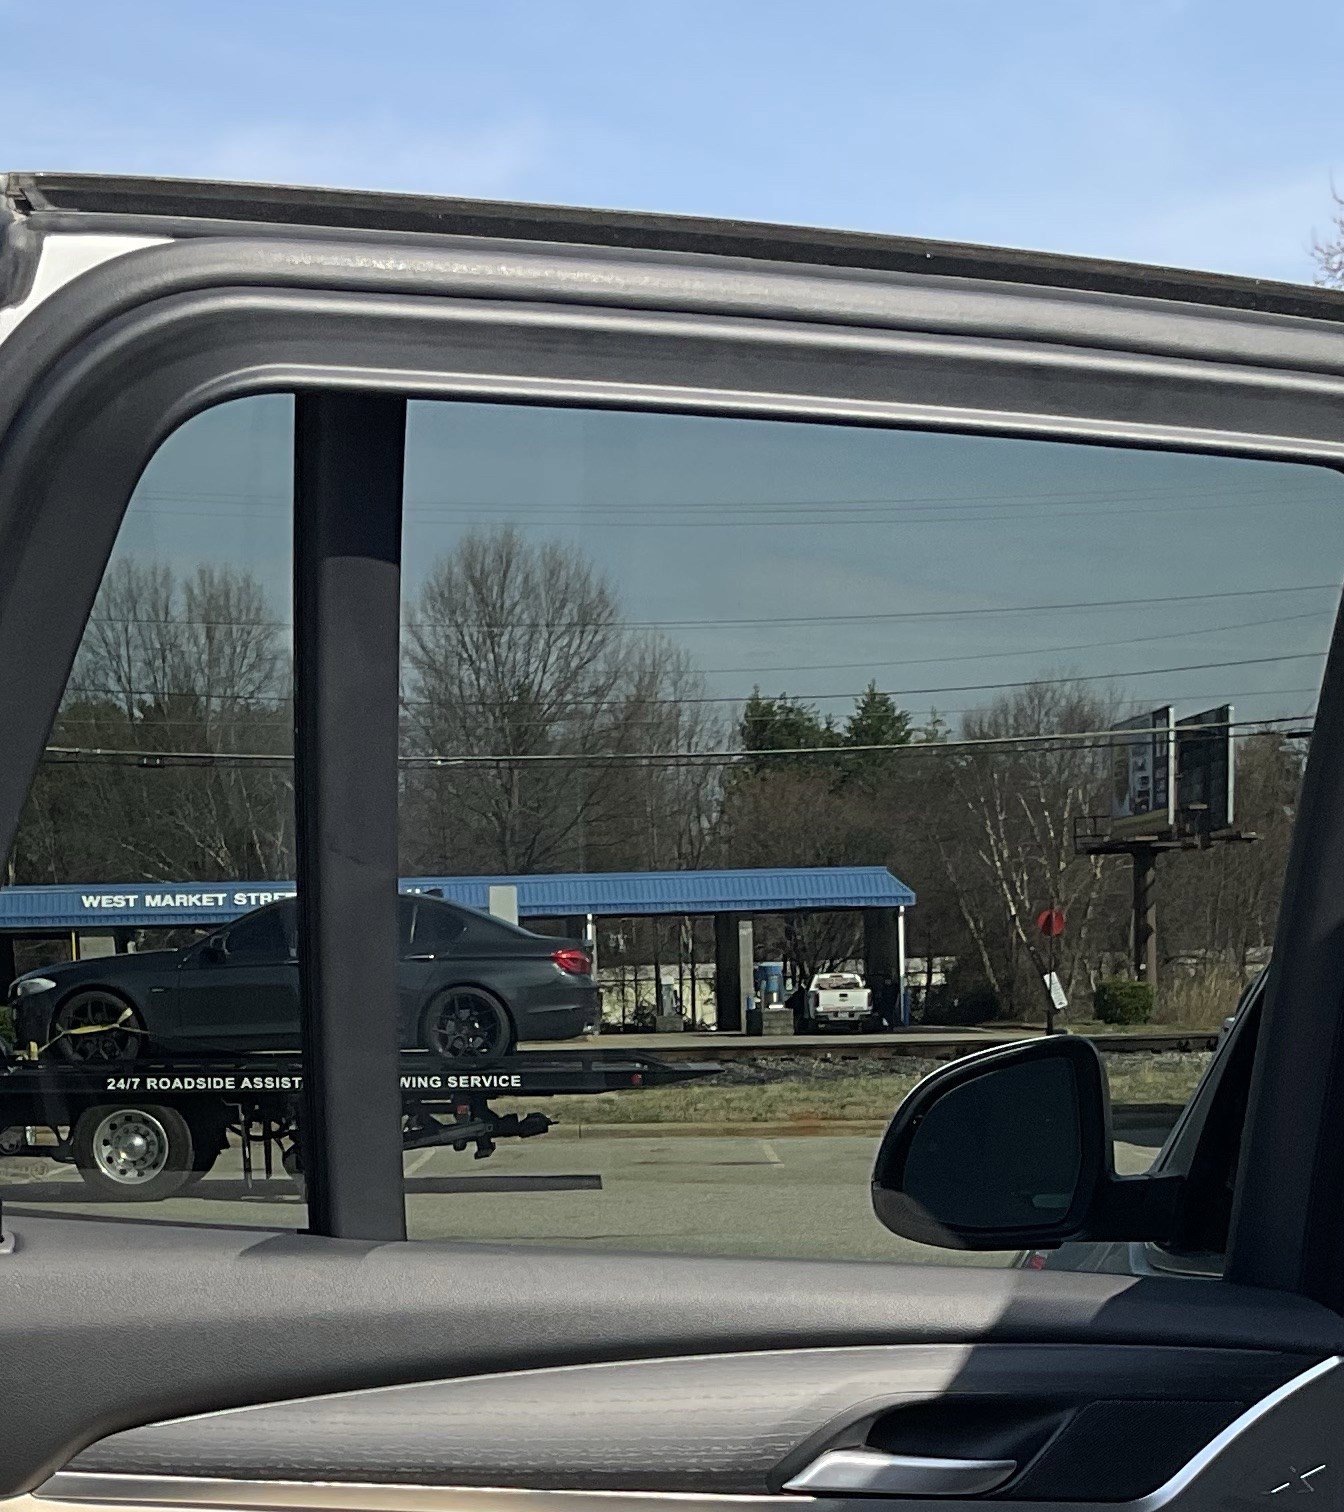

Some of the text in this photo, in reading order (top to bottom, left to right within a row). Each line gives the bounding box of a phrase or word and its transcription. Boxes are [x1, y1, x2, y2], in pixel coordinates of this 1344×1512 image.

[81, 894, 139, 908] WEST
[144, 893, 227, 907] MARKET
[106, 1077, 141, 1090] 24/7
[146, 1077, 236, 1090] ROADSIDE
[240, 1076, 304, 1090] ASSIST
[447, 1074, 522, 1088] SERVICE
